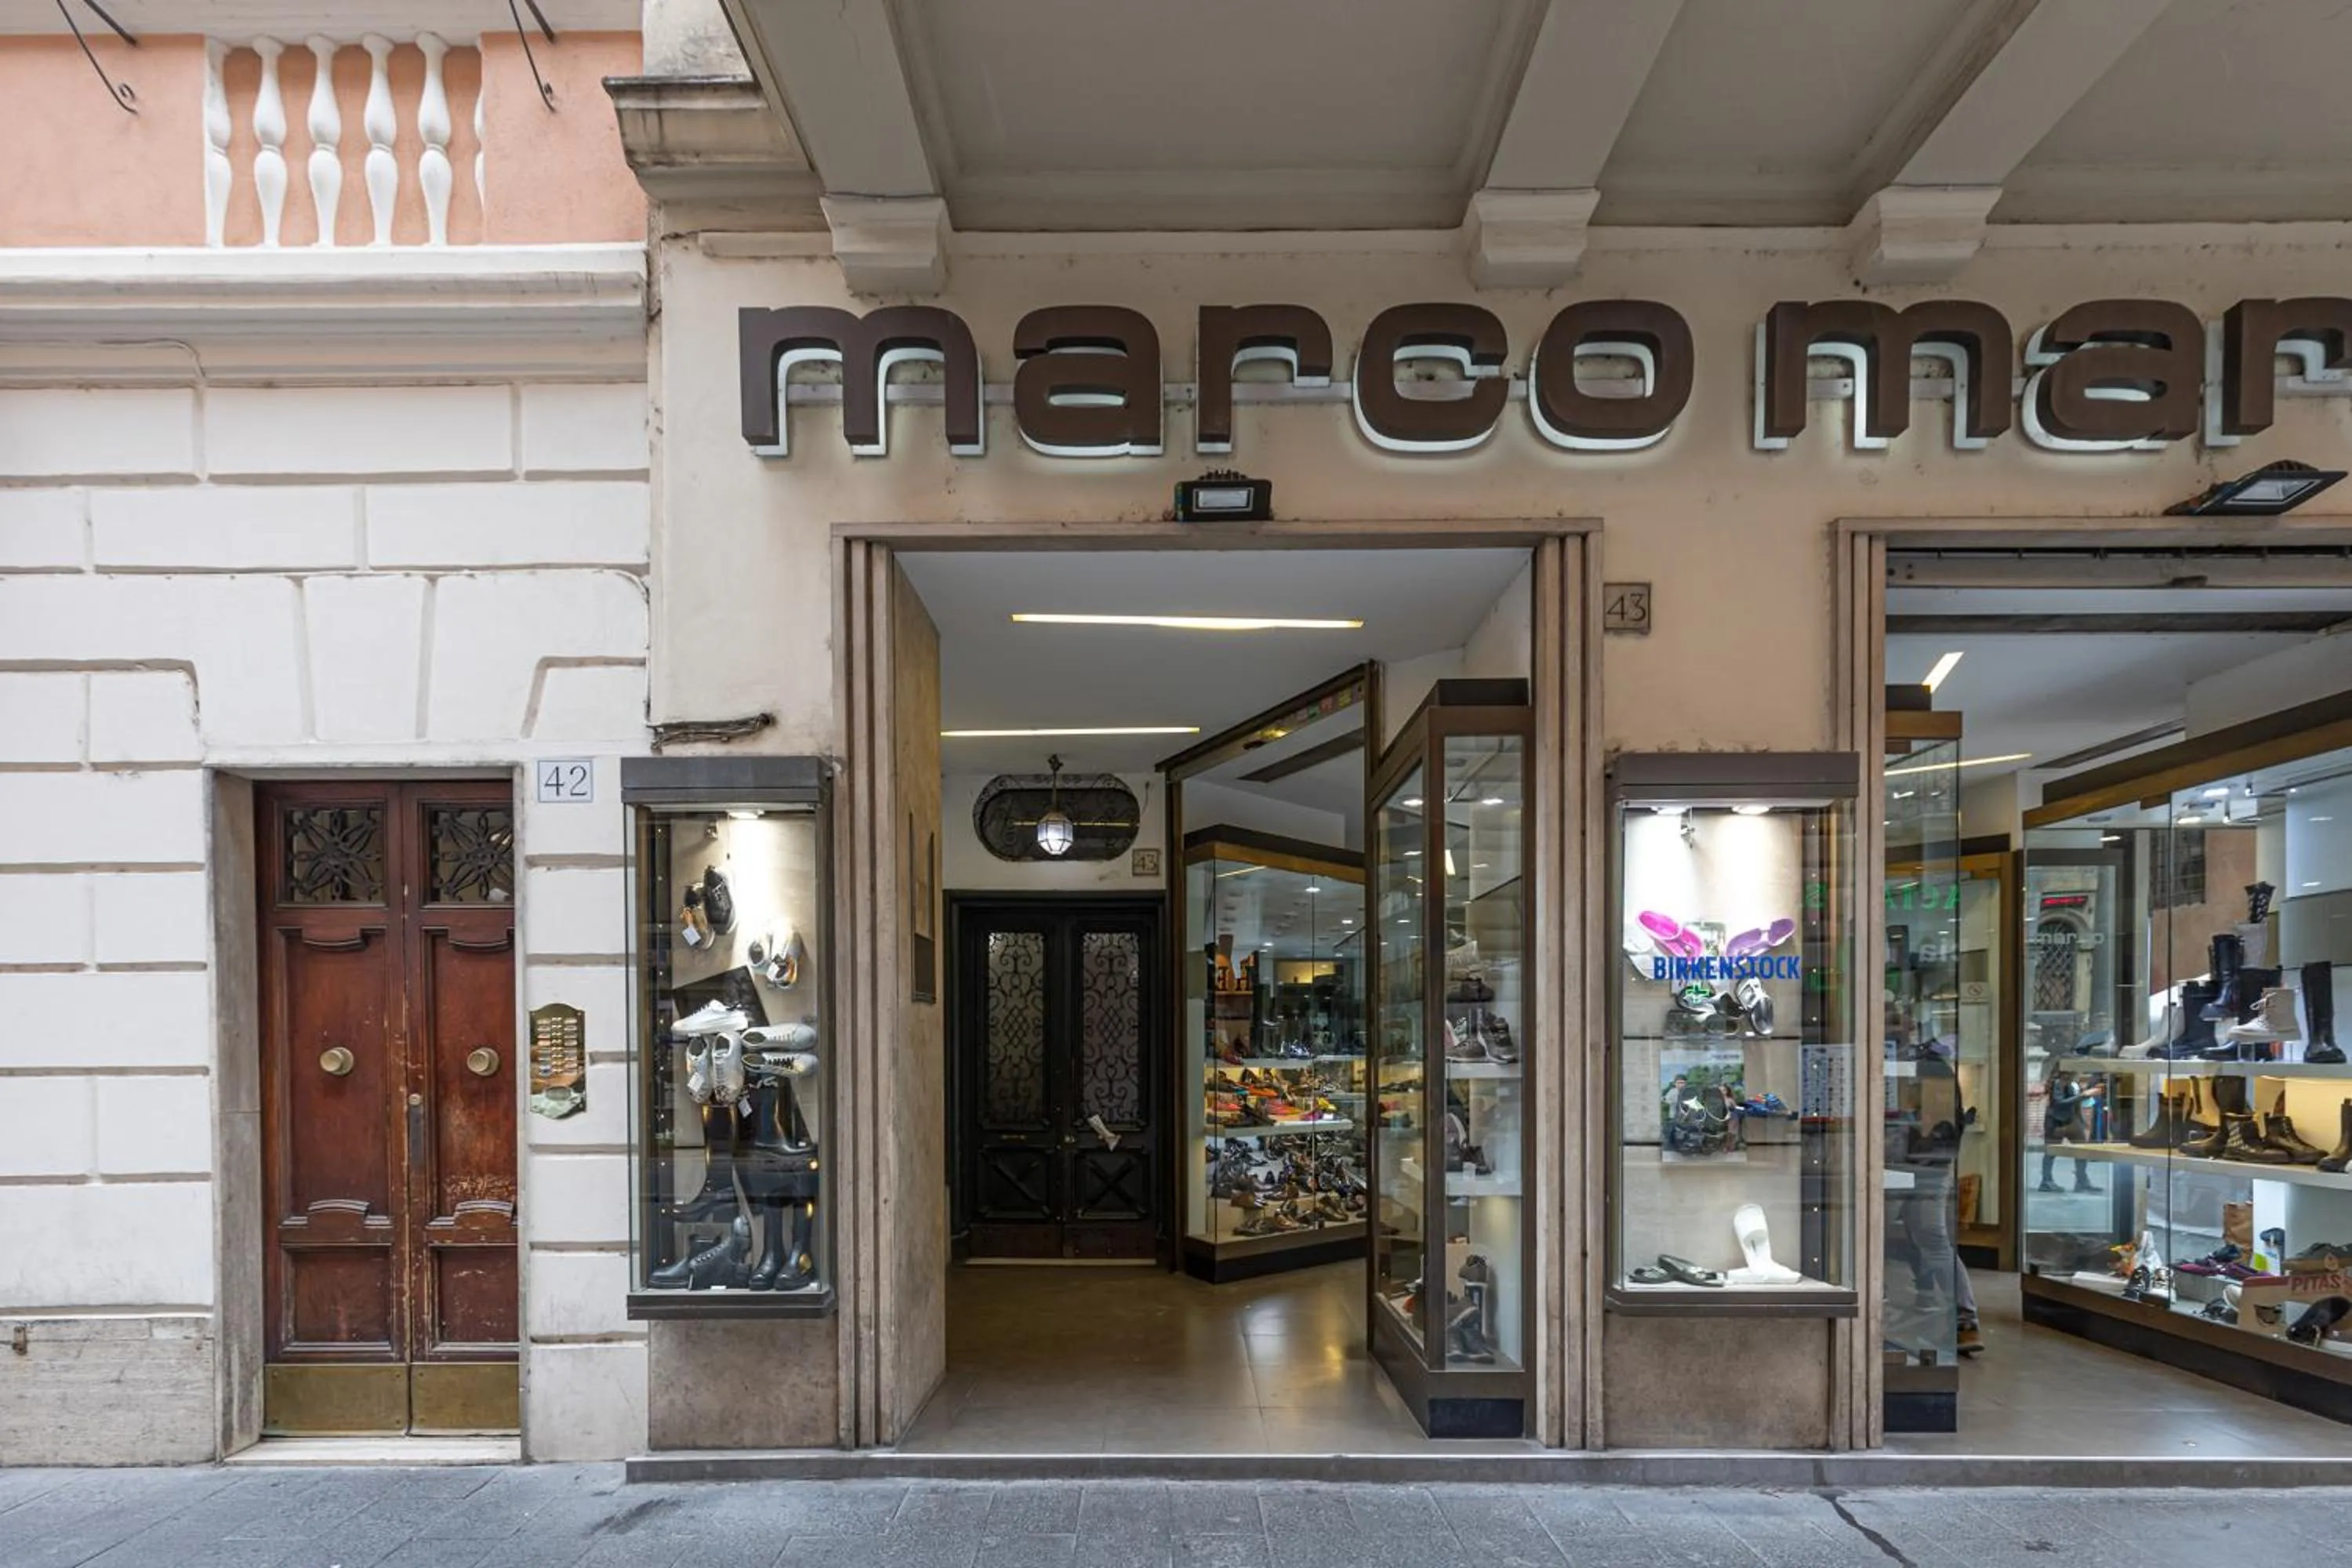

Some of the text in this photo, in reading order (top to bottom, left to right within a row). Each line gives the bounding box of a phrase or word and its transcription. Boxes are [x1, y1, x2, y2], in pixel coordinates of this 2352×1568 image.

[738, 299, 1694, 458] marco
[1606, 593, 1646, 622] 43
[544, 764, 588, 797] 42
[1133, 853, 1158, 871] 43
[1653, 956, 1801, 980] BIRKENSTOCK
[2291, 1273, 2342, 1292] PITAS
